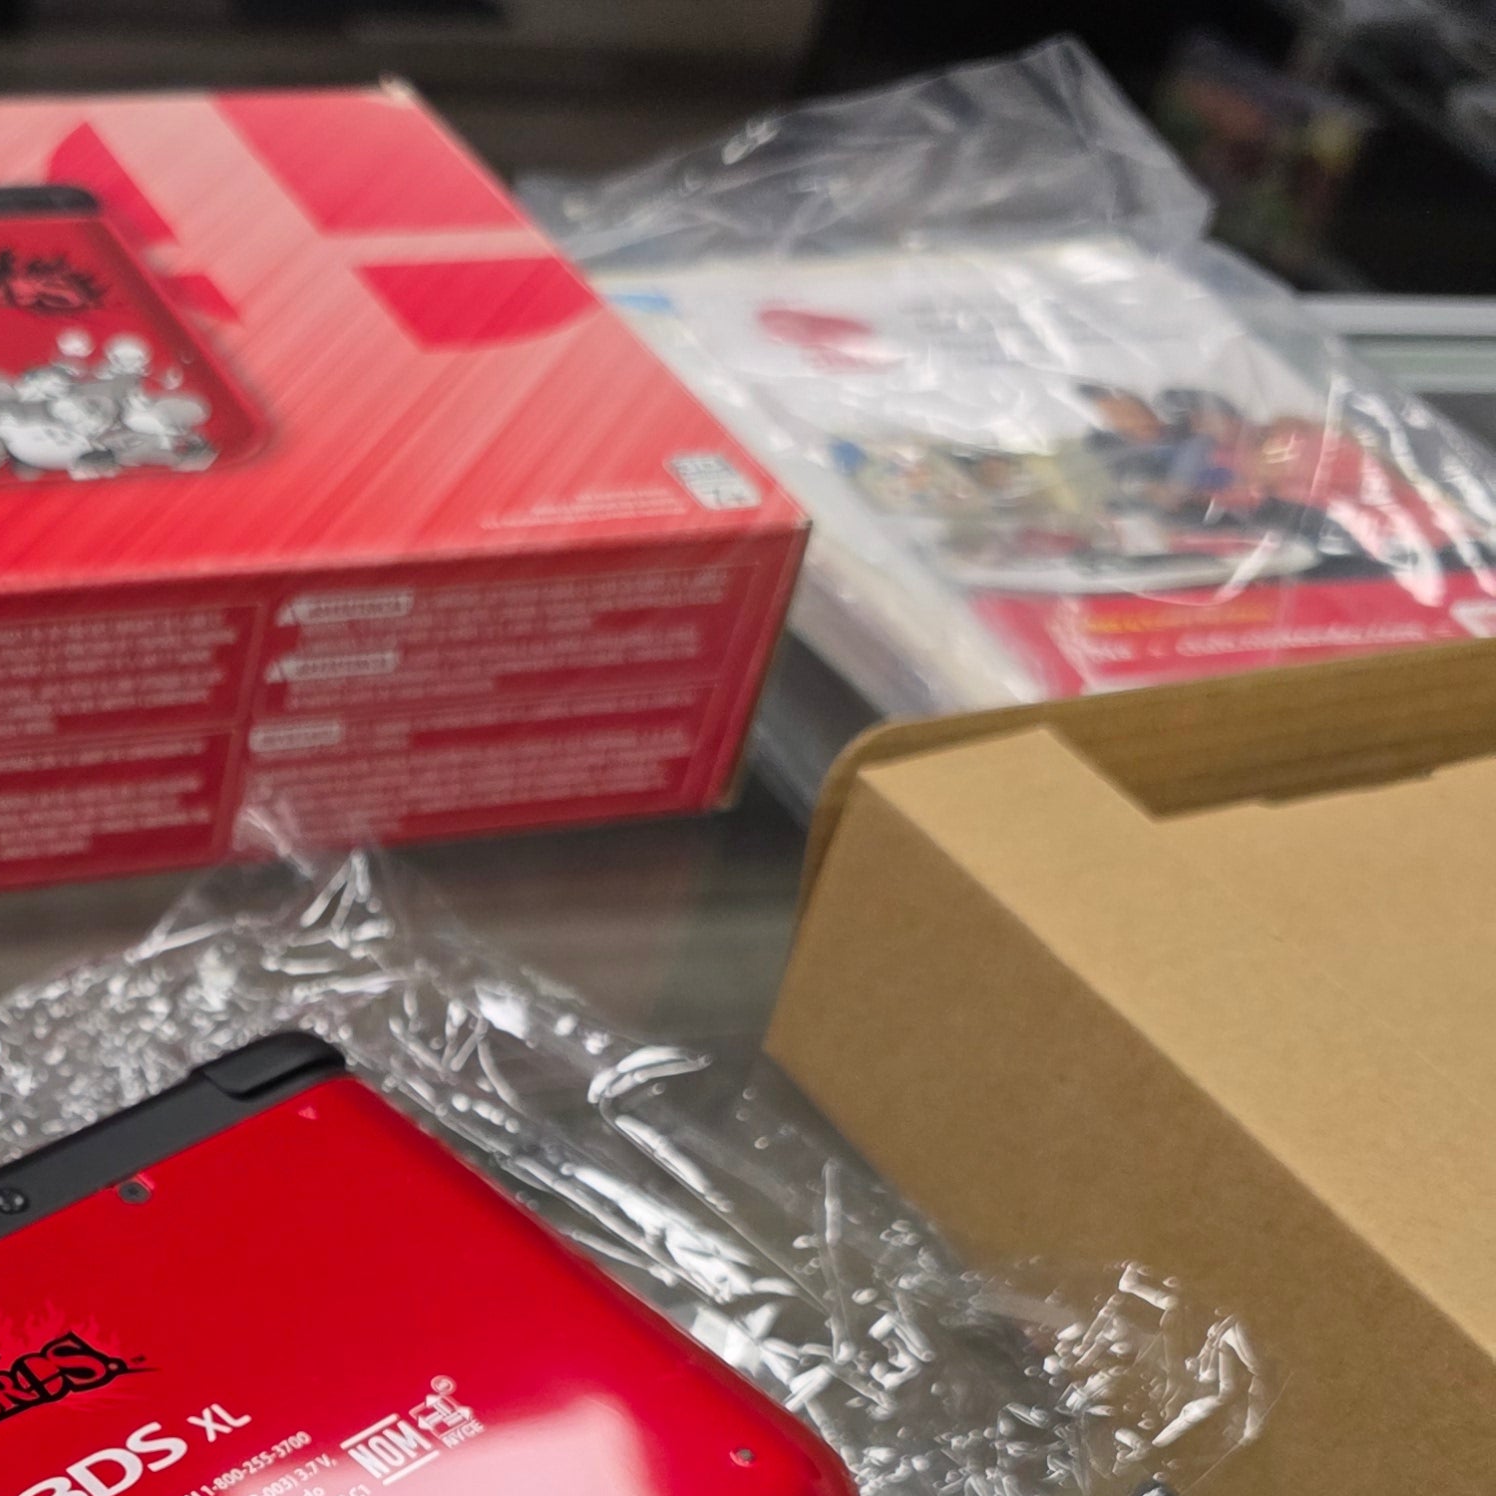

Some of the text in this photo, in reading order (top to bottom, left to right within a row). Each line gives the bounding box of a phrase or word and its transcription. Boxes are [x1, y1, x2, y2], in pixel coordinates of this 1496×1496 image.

[187, 1403, 252, 1443] XL
[200, 1431, 312, 1496] 1-800-255-3700
[294, 1461, 317, 1481] 3.7
[348, 1420, 433, 1479] NOM
